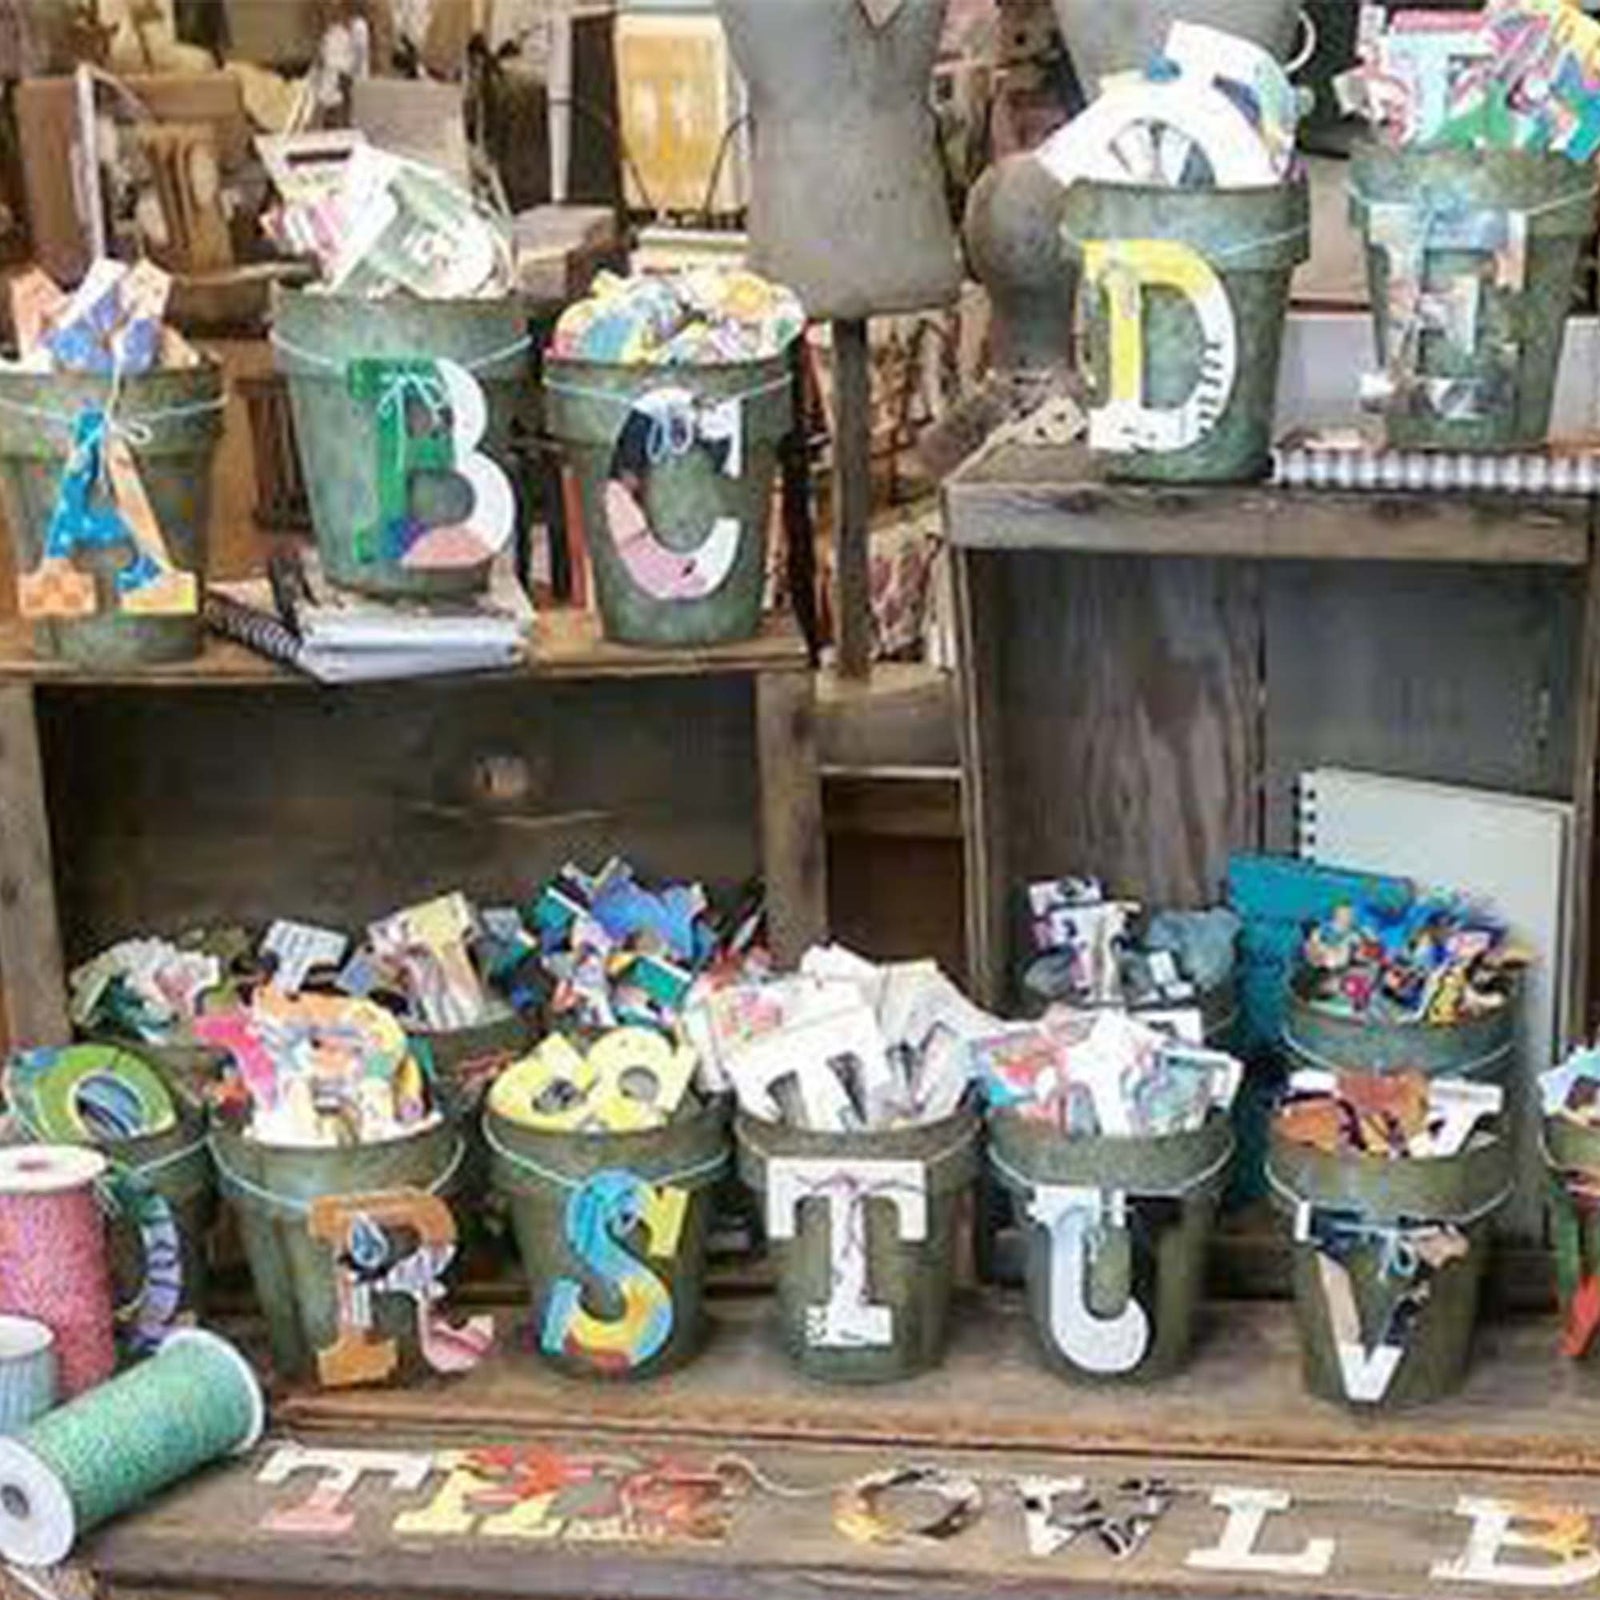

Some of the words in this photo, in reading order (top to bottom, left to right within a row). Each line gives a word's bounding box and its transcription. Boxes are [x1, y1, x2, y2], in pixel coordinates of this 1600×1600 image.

[1084, 238, 1237, 453] D
[18, 408, 197, 615] A
[348, 357, 517, 566] B
[605, 386, 743, 600] C
[306, 1188, 496, 1386] R
[540, 1170, 688, 1368] S
[766, 1160, 927, 1348] T
[1028, 1185, 1190, 1374] U
[1294, 1200, 1471, 1402] V
